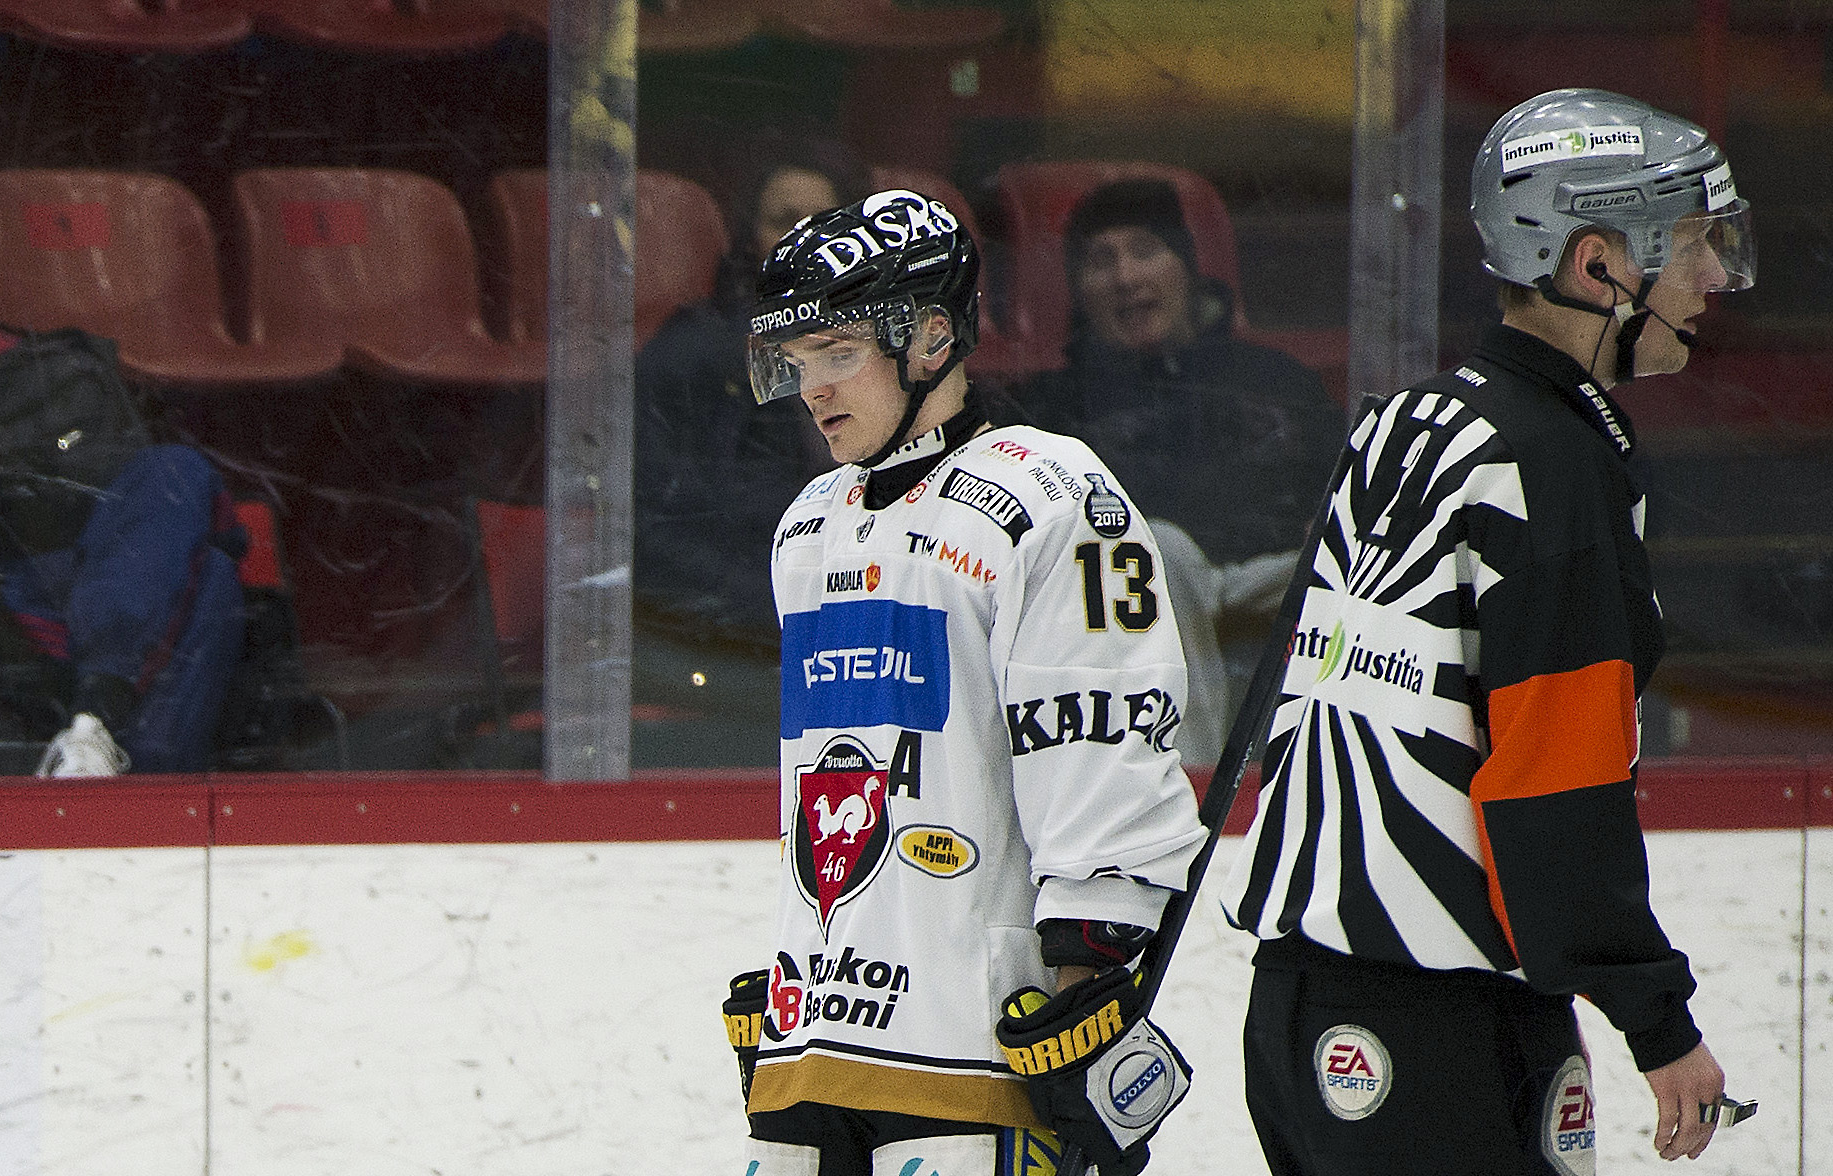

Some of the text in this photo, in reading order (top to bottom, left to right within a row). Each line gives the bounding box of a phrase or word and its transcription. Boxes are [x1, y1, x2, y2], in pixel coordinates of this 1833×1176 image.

[1503, 130, 1641, 162] intrum justitia
[814, 199, 959, 279] DISAS
[1093, 510, 1127, 528] 2015
[1075, 540, 1161, 634] 13
[1339, 634, 1425, 695] justitia
[888, 729, 923, 800] A
[925, 833, 954, 852] APPI
[820, 851, 847, 883] 46
[1327, 1044, 1377, 1077] EA
[1116, 1059, 1164, 1109] VOLVO
[1325, 1074, 1379, 1092] SPORTS
[1557, 1130, 1596, 1152] SPOR
